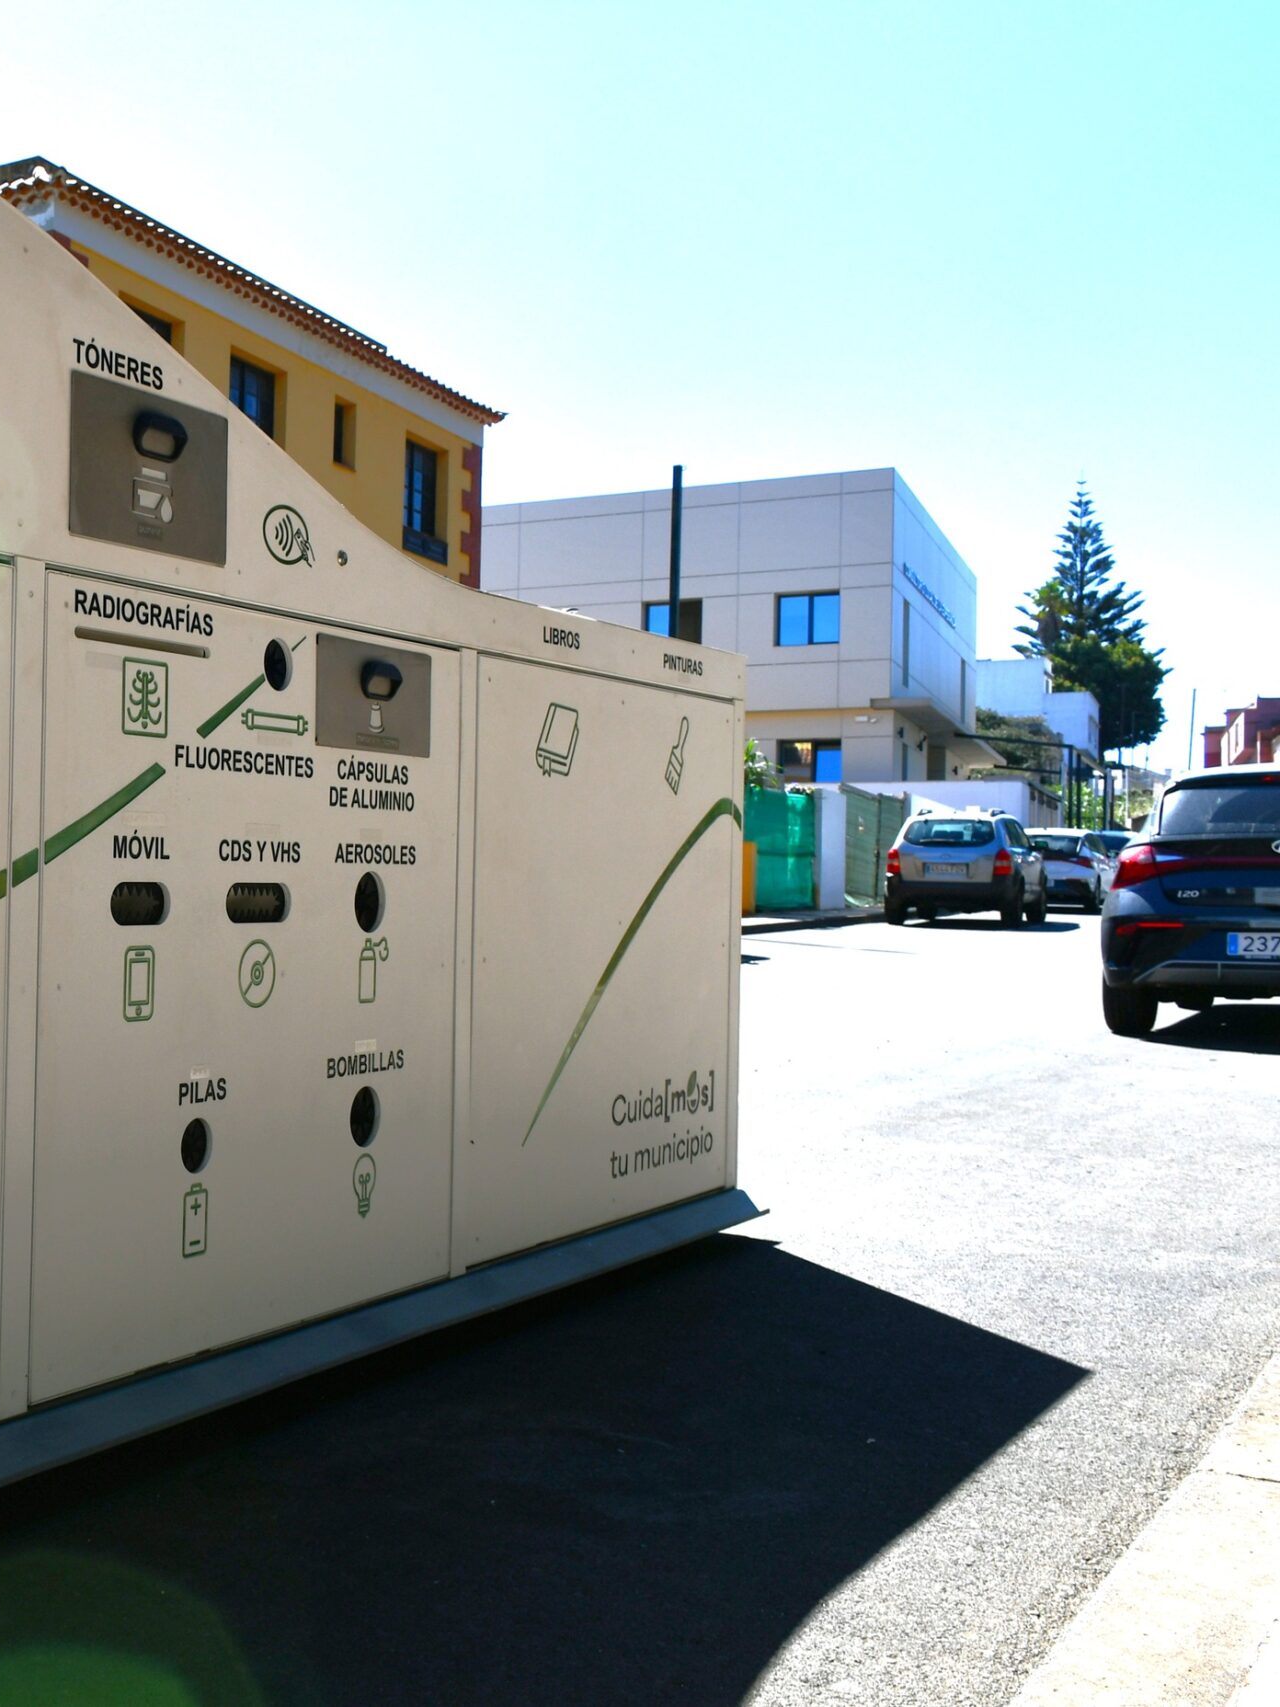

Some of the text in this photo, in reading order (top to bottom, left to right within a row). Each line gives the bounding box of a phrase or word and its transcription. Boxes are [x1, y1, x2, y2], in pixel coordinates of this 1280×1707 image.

[73, 338, 164, 390] TÓNERES
[74, 589, 214, 636] RADIOGRAFÍAS
[543, 626, 580, 650] LIBROS
[663, 653, 703, 676] PINTURAS
[174, 745, 314, 779] FLUORESCENTES
[337, 756, 409, 785] CÁPSULAS
[329, 786, 415, 812] DE ALUMINIO
[113, 828, 170, 860] MÓVIL
[219, 839, 301, 863] CDS Y VHS
[335, 843, 416, 865] AEROSOLES
[326, 1049, 404, 1079] BOMBILLAS
[178, 1078, 227, 1106] PILAS
[610, 1125, 713, 1179] tu municipio
